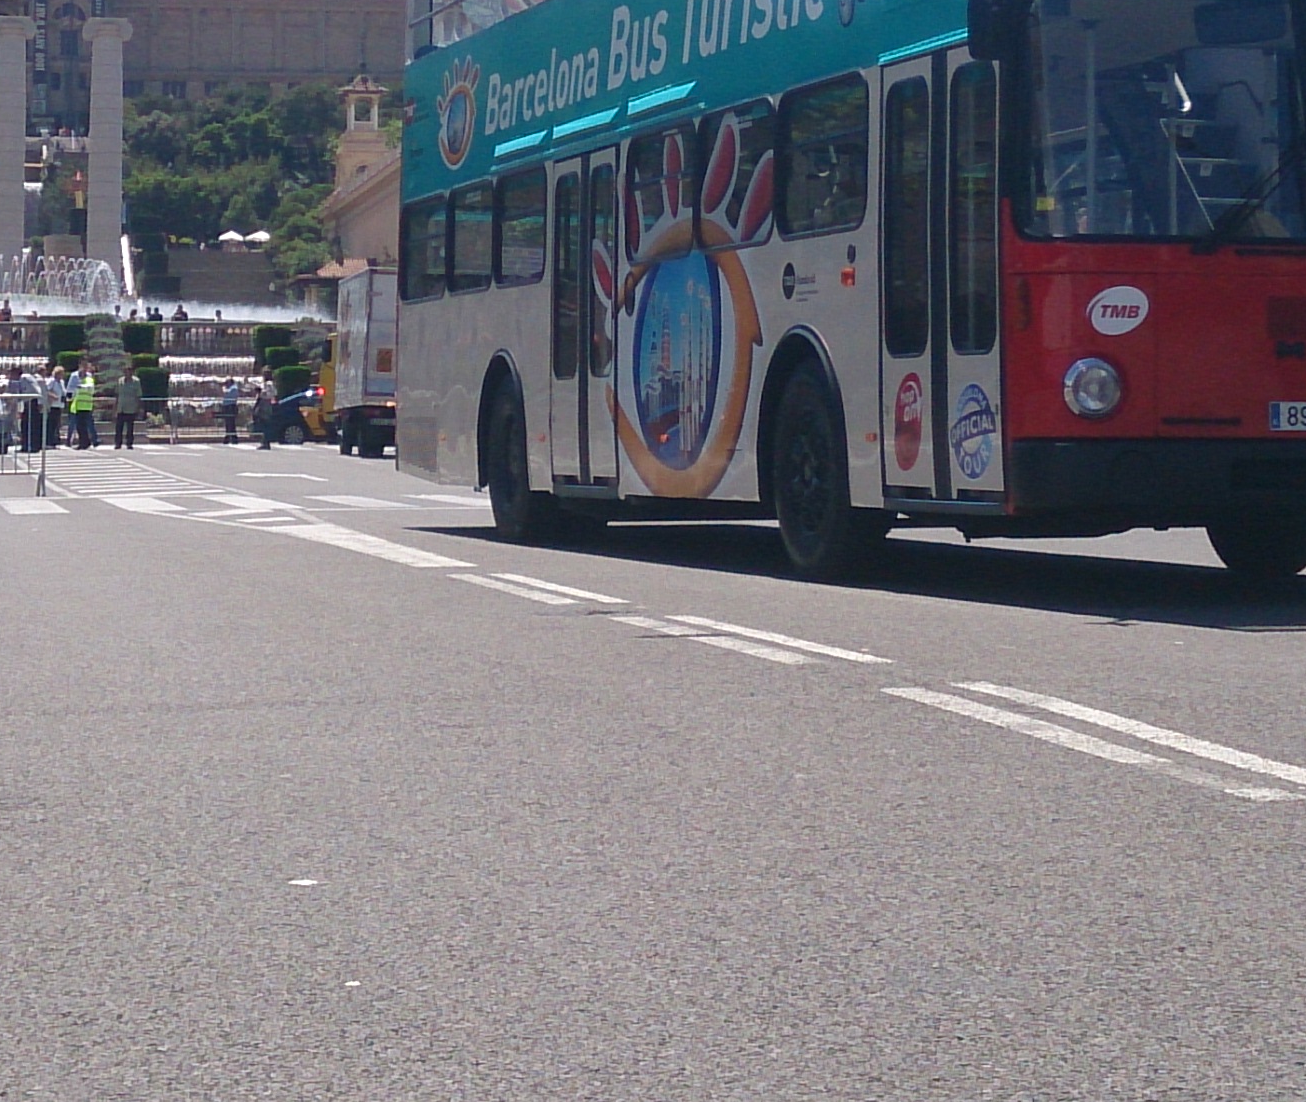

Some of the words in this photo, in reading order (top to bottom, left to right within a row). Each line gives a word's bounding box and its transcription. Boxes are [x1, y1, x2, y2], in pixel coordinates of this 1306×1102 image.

[485, 47, 599, 136] Barcelona
[607, 5, 669, 91] Bus
[1100, 304, 1141, 319] TMB
[951, 413, 994, 444] OFFICIAL
[959, 444, 990, 475] TOUR
